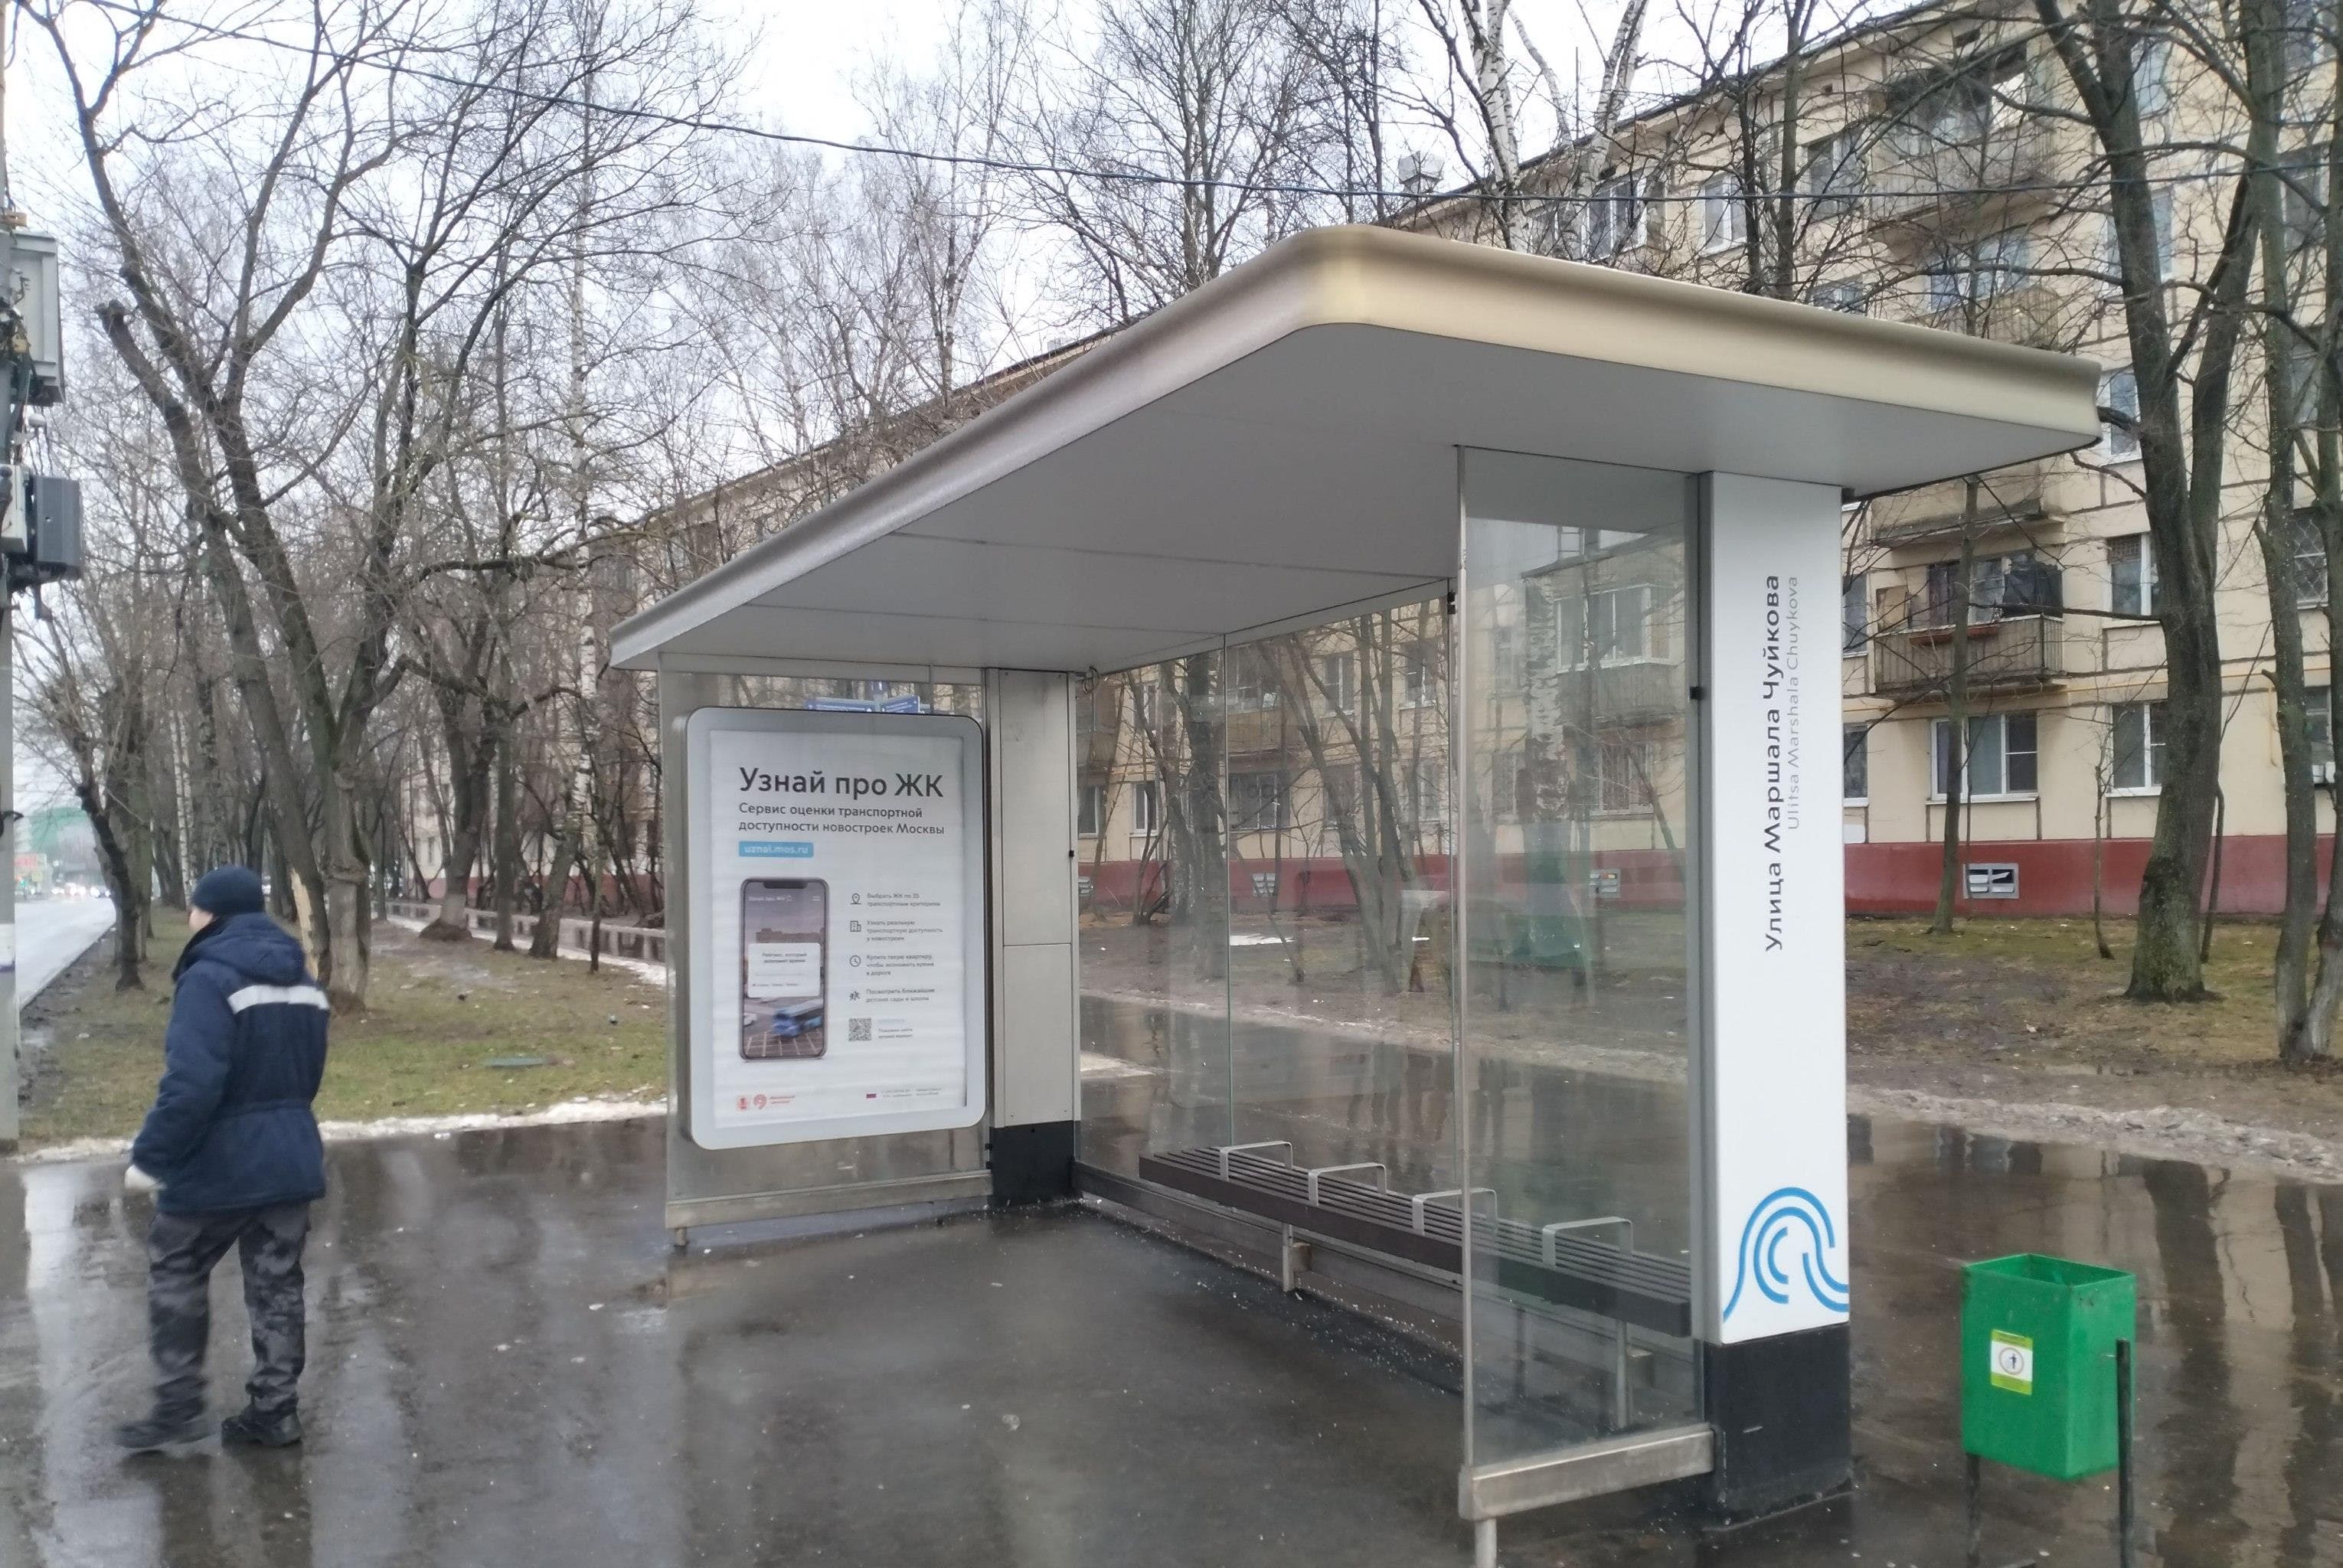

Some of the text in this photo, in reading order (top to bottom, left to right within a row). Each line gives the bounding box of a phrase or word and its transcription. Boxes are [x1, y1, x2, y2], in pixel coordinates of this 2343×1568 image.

[1786, 577, 1800, 829] Ulitsa Marshala Chuykova
[1763, 576, 1785, 952] Улица Маршала Чуйкова
[739, 766, 944, 800] Узнай про ЖК
[739, 802, 923, 820] Сервис оценки транспортной
[739, 822, 945, 835] доступности новостроек Москвы
